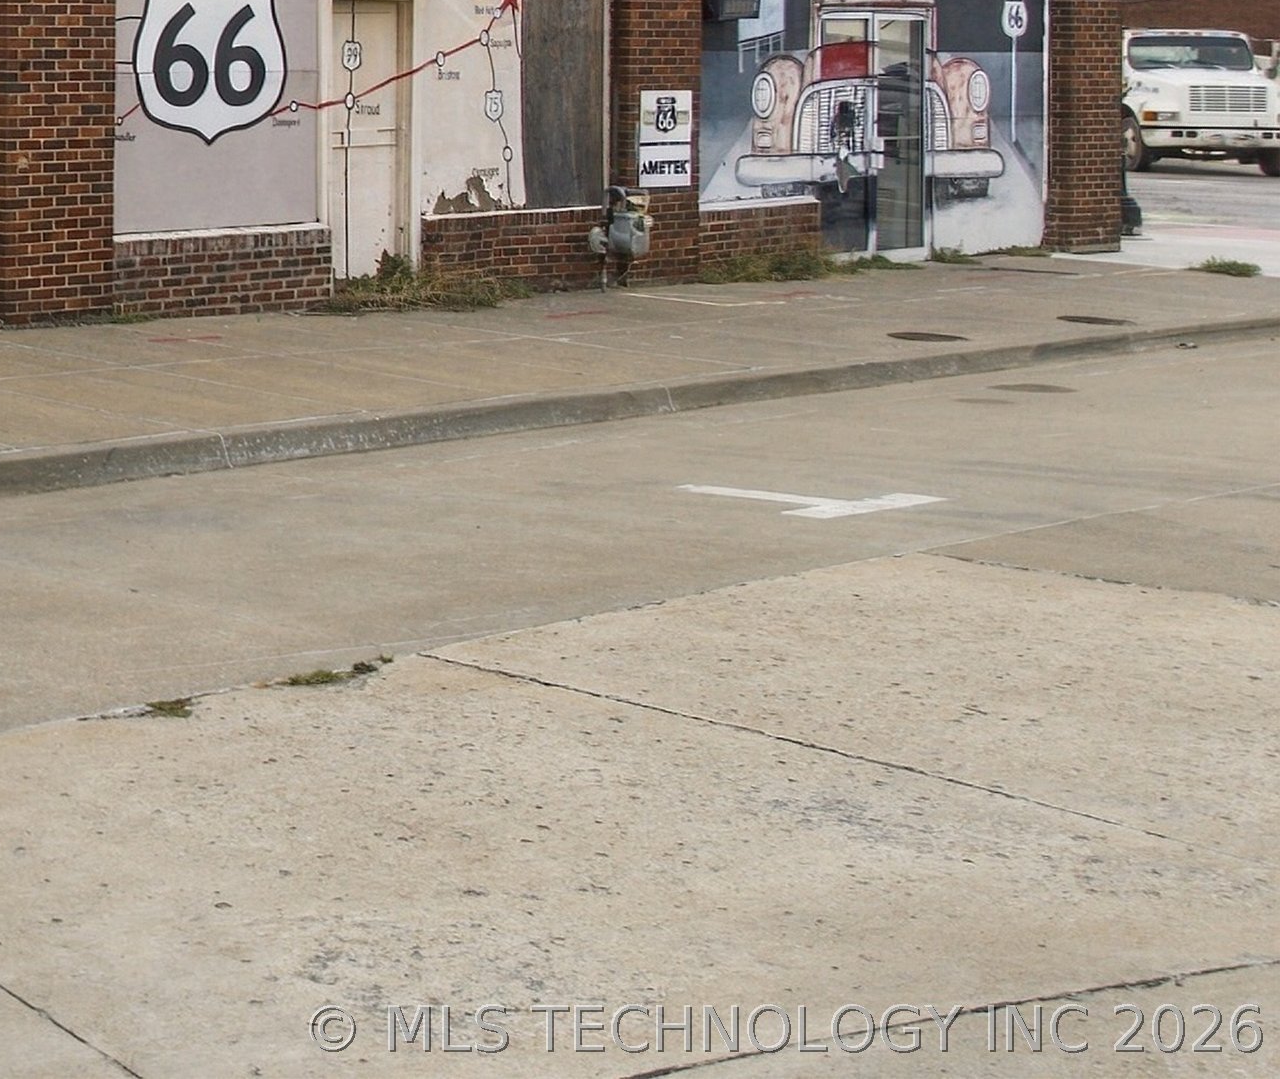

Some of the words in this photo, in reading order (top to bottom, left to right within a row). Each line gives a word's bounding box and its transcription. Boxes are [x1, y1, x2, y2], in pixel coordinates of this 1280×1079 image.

[1007, 5, 1024, 29] 66
[152, 2, 267, 107] 66
[347, 46, 361, 64] 99
[658, 110, 675, 130] 66
[640, 160, 690, 176] AMETEK
